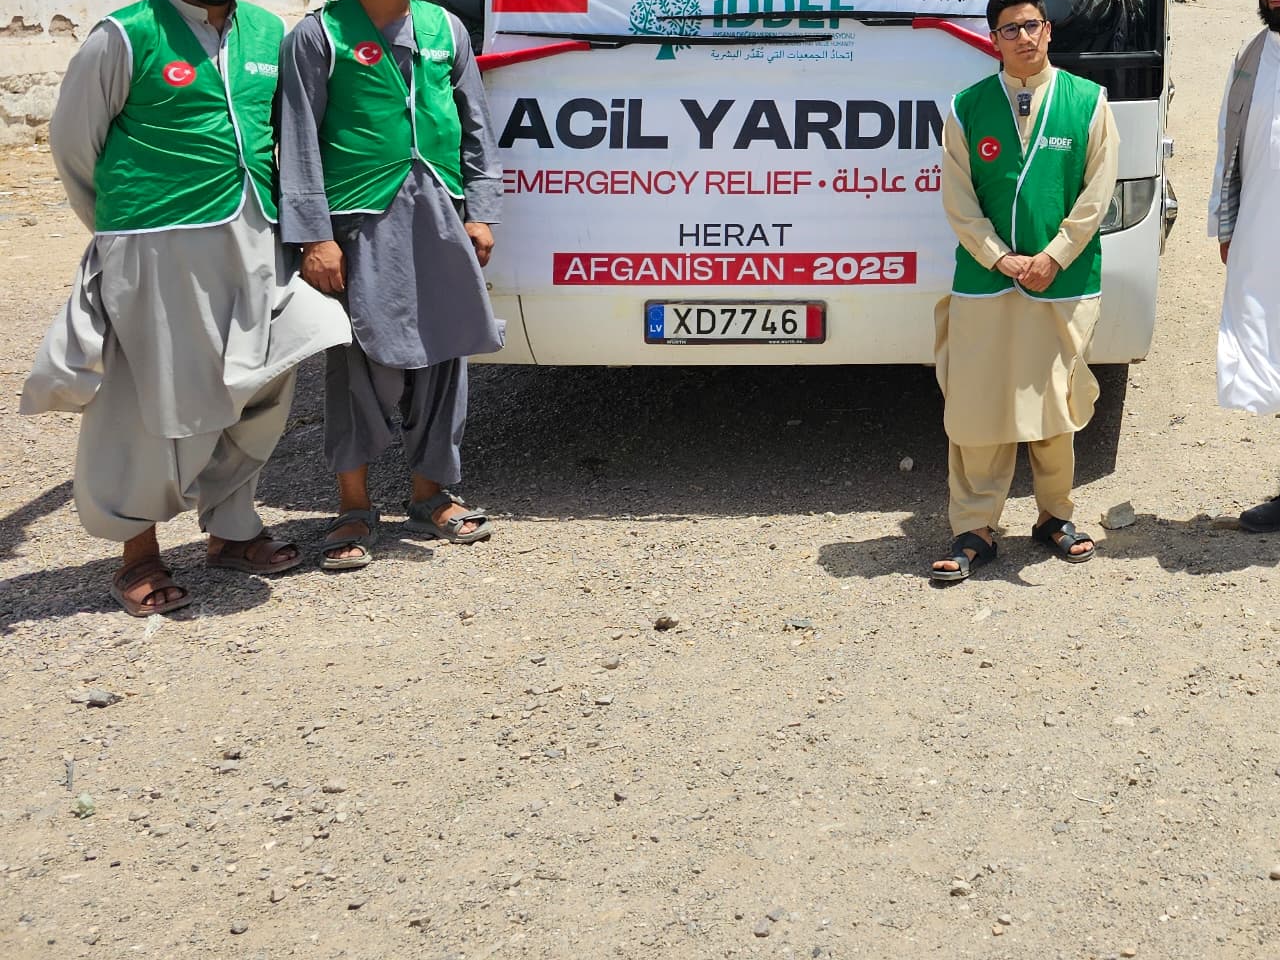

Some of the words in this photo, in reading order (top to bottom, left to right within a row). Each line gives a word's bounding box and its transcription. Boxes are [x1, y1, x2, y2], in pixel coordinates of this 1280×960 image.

[502, 169, 699, 195] EMERGENCY
[705, 170, 813, 195] RELIEF
[833, 167, 906, 199] عاجلة
[679, 223, 793, 247] HERAT
[812, 256, 906, 281] 2025
[650, 324, 662, 333] LV
[672, 308, 798, 335] XD7746
